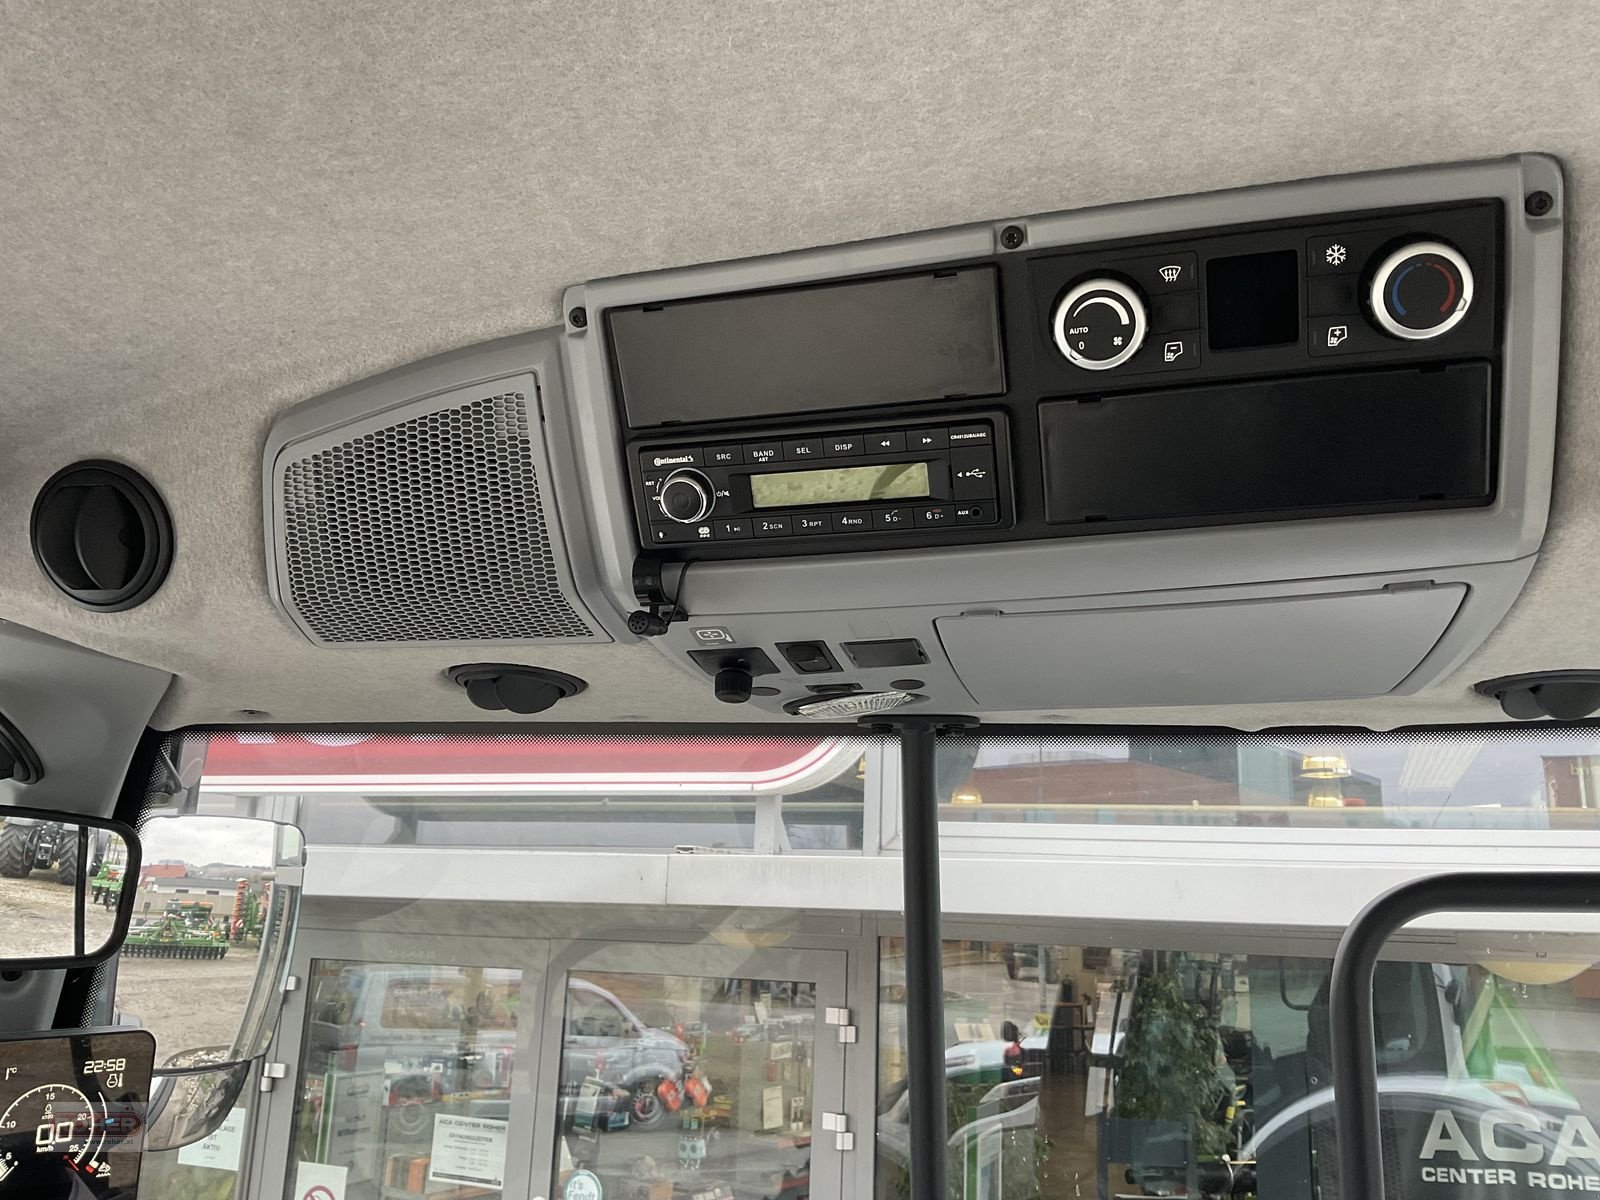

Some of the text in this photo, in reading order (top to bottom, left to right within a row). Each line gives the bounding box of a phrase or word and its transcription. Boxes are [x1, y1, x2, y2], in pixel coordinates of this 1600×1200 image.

[1069, 326, 1089, 335] AUTO
[1078, 341, 1085, 350] 0
[834, 443, 853, 451] DISP
[716, 453, 732, 461] SRC
[753, 450, 774, 458] BAND
[653, 456, 688, 467] Continental
[885, 514, 891, 522] 5
[926, 511, 932, 520] 6
[801, 520, 808, 528] 3
[841, 517, 848, 525] 4
[725, 524, 731, 533] 1
[762, 522, 769, 530] 2
[83, 1058, 126, 1074] 22:58
[45, 1093, 56, 1101] 15
[76, 1113, 87, 1121] 20
[5, 1120, 16, 1129] 10
[35, 1121, 74, 1145] 0.0
[1419, 1109, 1600, 1167] ACA
[36, 1145, 54, 1153] km/h
[68, 1144, 79, 1152] 25
[1421, 1167, 1517, 1185] CENTER
